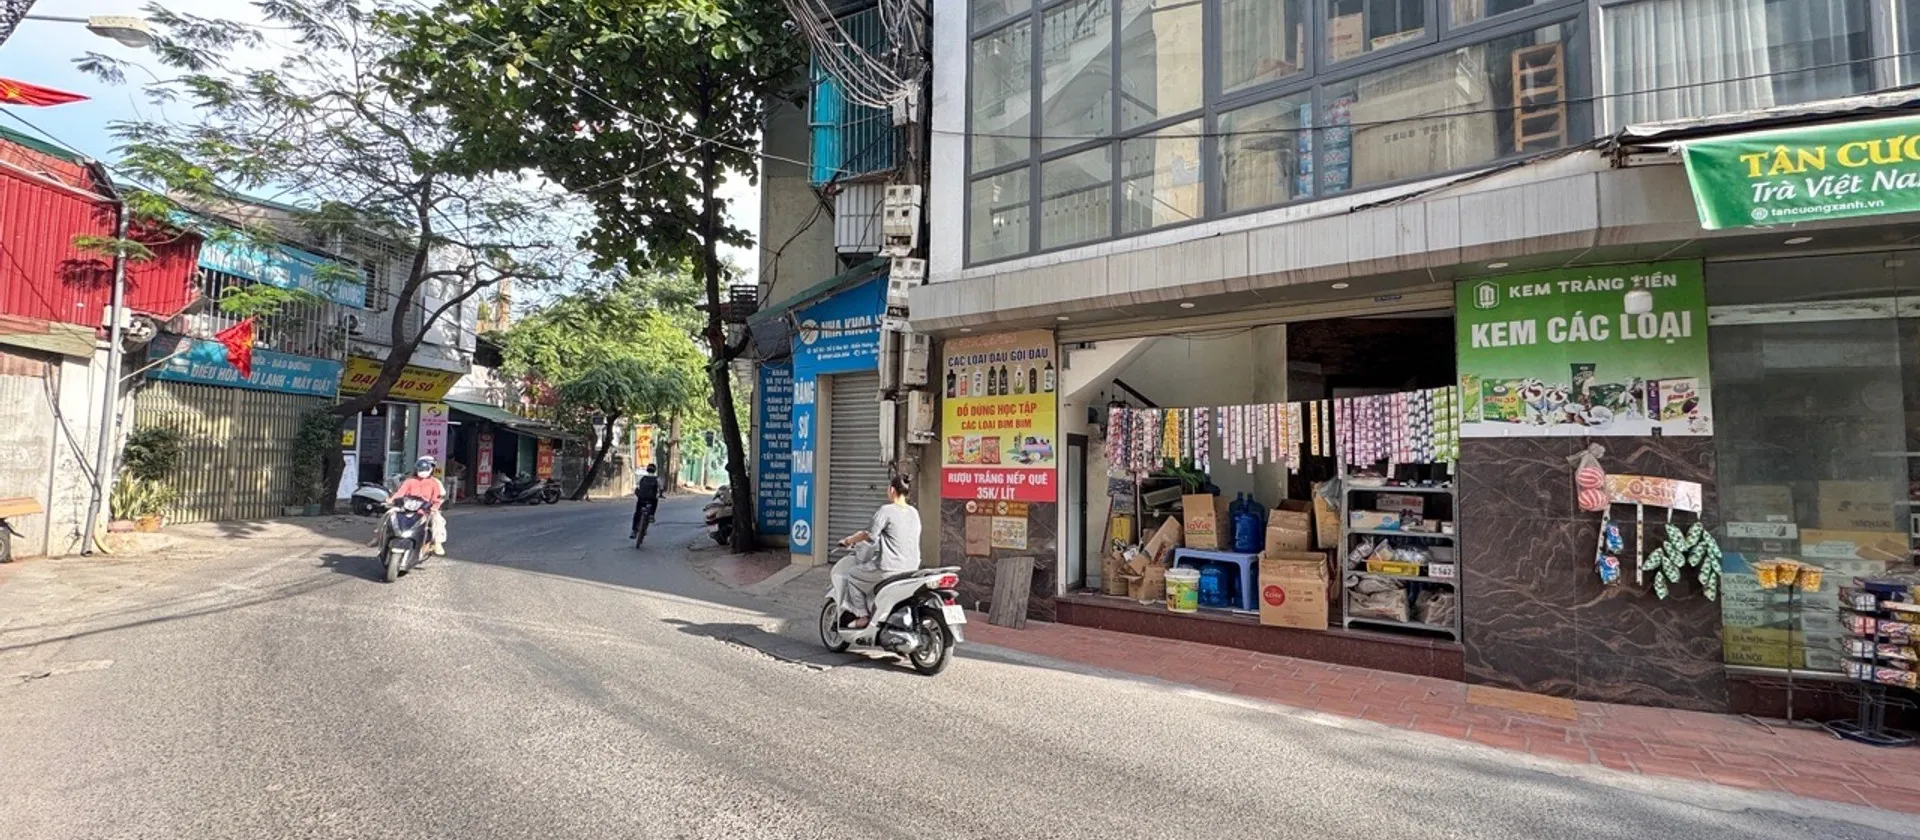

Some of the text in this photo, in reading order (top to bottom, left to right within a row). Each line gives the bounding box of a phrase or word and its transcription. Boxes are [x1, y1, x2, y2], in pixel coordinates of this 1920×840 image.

[1740, 144, 1826, 178] TÂN
[1751, 170, 1920, 203] Trà Việt Na
[1771, 199, 1885, 217] tancuongxanh.vn
[1509, 283, 1550, 298] KEM
[1557, 276, 1624, 293] TRÀNG
[821, 320, 842, 339] NHA
[844, 315, 872, 336] KHOA
[1471, 310, 1692, 348] KEM CÁC LOẠI
[191, 361, 214, 380] ĐIỀU
[217, 366, 238, 382] HÒA
[260, 372, 286, 389] LẠNH
[292, 375, 312, 390] MÁY
[793, 377, 814, 404] RĂNG
[957, 401, 1037, 417] ĐỒ DÙNG HỌC TẬP
[798, 411, 810, 438] SỨ
[961, 418, 1032, 431] CÁC LOẠI BIM BIM
[792, 441, 813, 473] THẨM
[948, 470, 1048, 486] RƯỢU TRẮNG NẾP QUÊ
[976, 485, 1015, 499] 35K/ LÍT
[794, 524, 808, 541] 22
